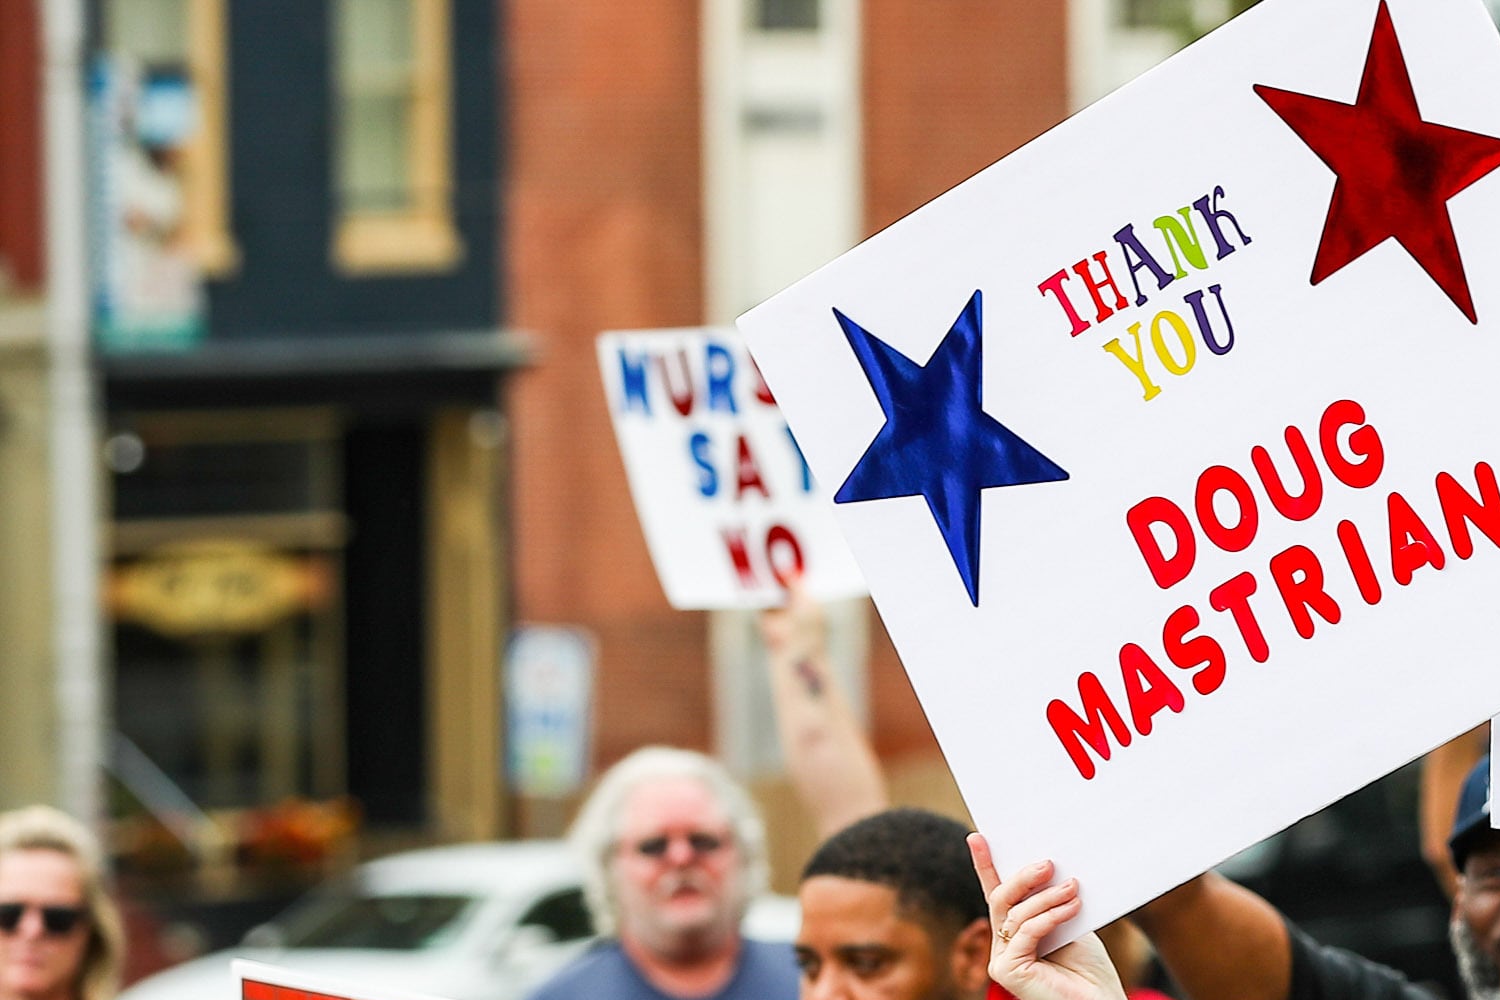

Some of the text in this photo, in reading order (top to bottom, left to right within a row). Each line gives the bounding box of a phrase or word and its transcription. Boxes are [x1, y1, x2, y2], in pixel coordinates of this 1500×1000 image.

[1038, 186, 1251, 337] THANK
[1104, 285, 1235, 401] YOU
[1127, 400, 1385, 589] DOUG
